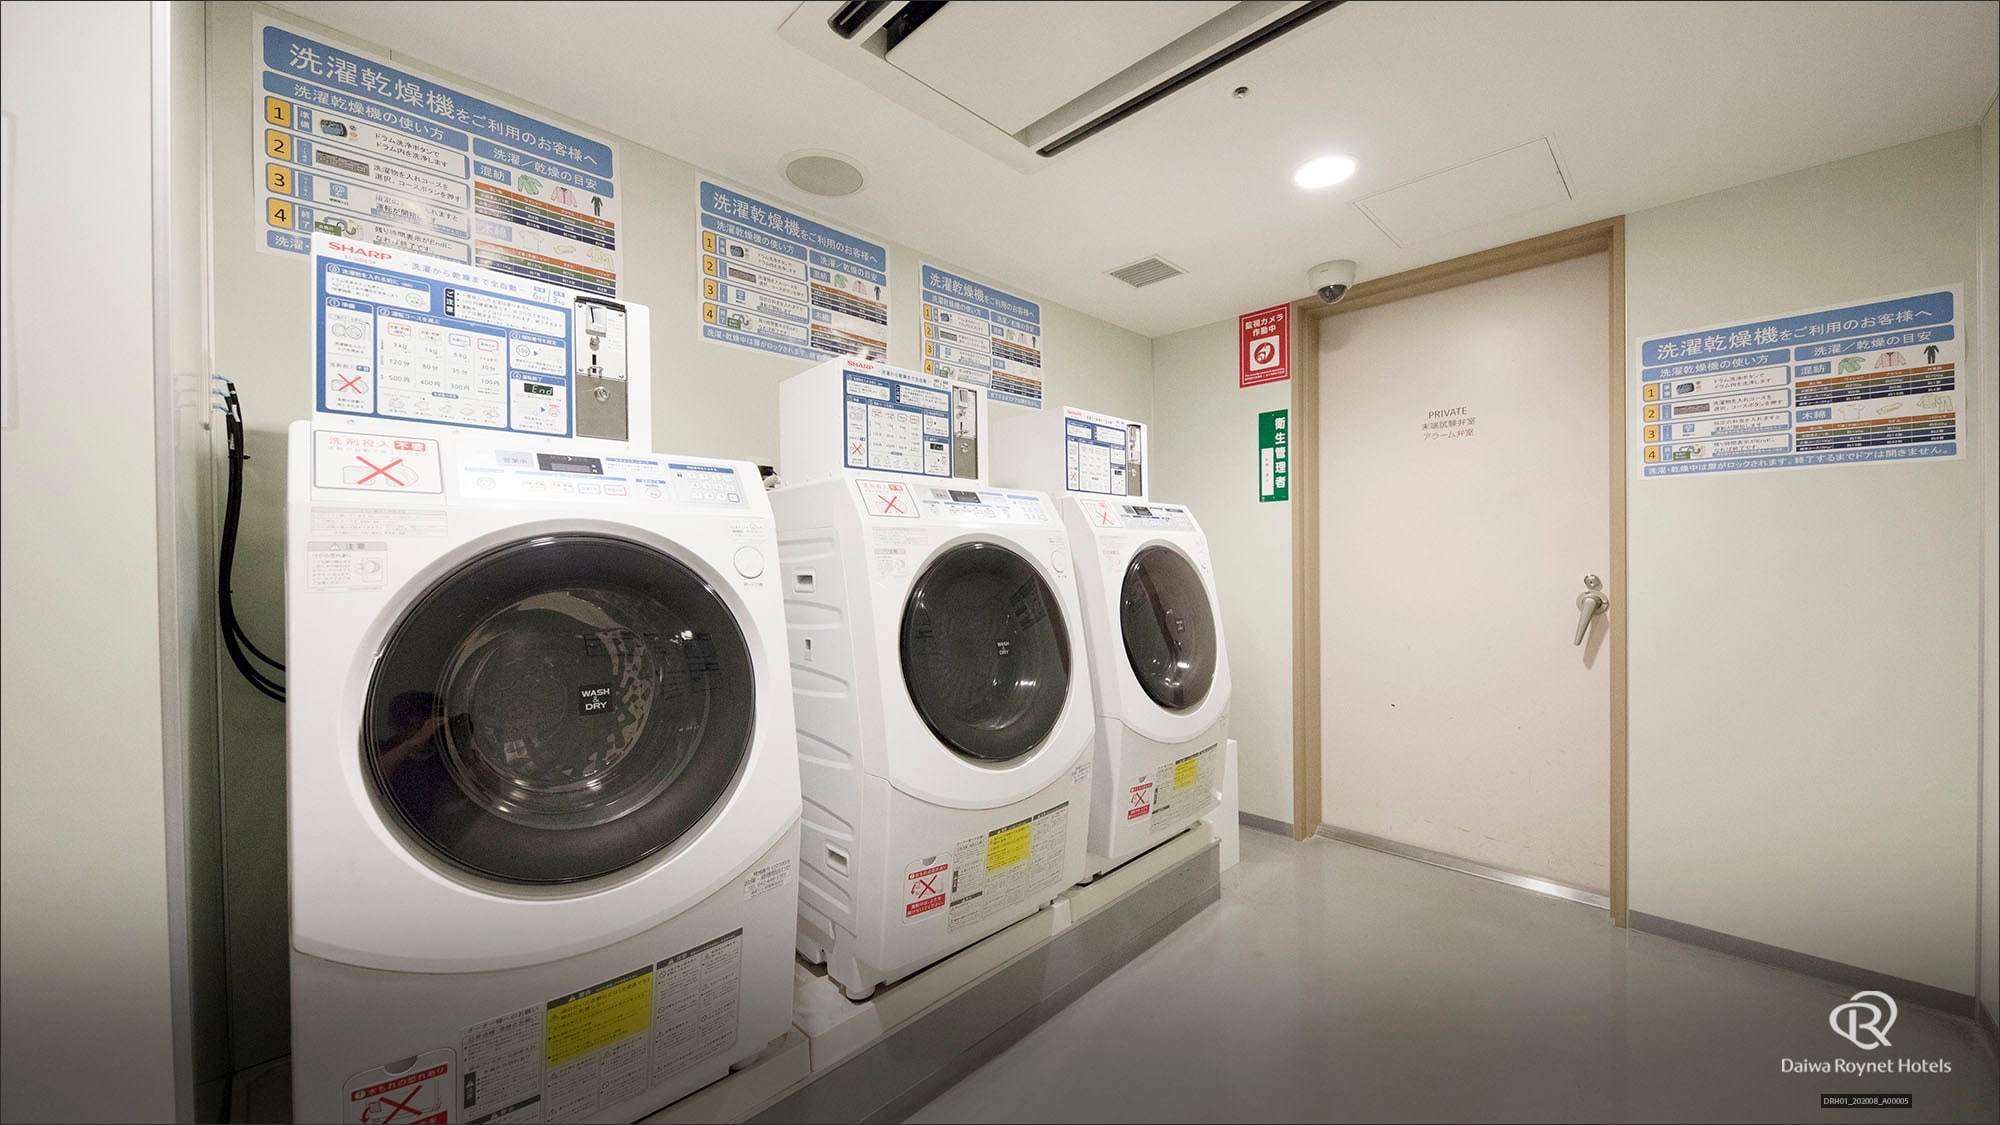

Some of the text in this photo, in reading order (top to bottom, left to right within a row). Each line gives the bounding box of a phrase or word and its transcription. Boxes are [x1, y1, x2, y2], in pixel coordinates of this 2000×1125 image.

[289, 43, 598, 166] 洗濯乾燥機をご利用のお客様へ
[274, 107, 285, 121] 1
[294, 84, 444, 140] 洗濯乾燥機の使い方
[273, 139, 285, 154] 2
[480, 165, 506, 182] 混紡
[274, 173, 285, 187] 3
[274, 208, 286, 222] 4
[713, 191, 878, 263] 洗濯乾燥機をご利用のお客様へ
[706, 238, 712, 248] 1
[716, 220, 795, 254] 洗濯乾燥機の使い方
[328, 241, 392, 260] SHARP
[706, 261, 713, 272] 2
[706, 284, 714, 295] 3
[929, 272, 1035, 318] 洗濯乾燥機をご利用のお客様へ
[706, 309, 713, 320] 4
[1245, 313, 1284, 330] 監視カメラ
[926, 326, 931, 335] 2
[1252, 325, 1276, 337] 作動中
[1657, 310, 1933, 360] 洗濯乾燥機をご利用のお客様へ
[927, 345, 932, 353] 3
[847, 360, 874, 370] SHARP
[926, 363, 932, 372] 4
[1660, 354, 1769, 378] 洗濯乾燥機の使い方
[1800, 363, 1826, 375] 混紡
[531, 384, 554, 396] End
[1648, 389, 1654, 397] 1
[1428, 406, 1467, 419] PRIVATE
[1648, 409, 1655, 419] 2
[1801, 409, 1826, 420] 木綿
[1648, 429, 1655, 439] 3
[328, 436, 425, 452] 洗剤投入 不要
[1274, 416, 1286, 489] 衛生管理者
[1648, 450, 1656, 460] 4
[581, 688, 611, 698] WASH
[585, 701, 607, 711] DRY
